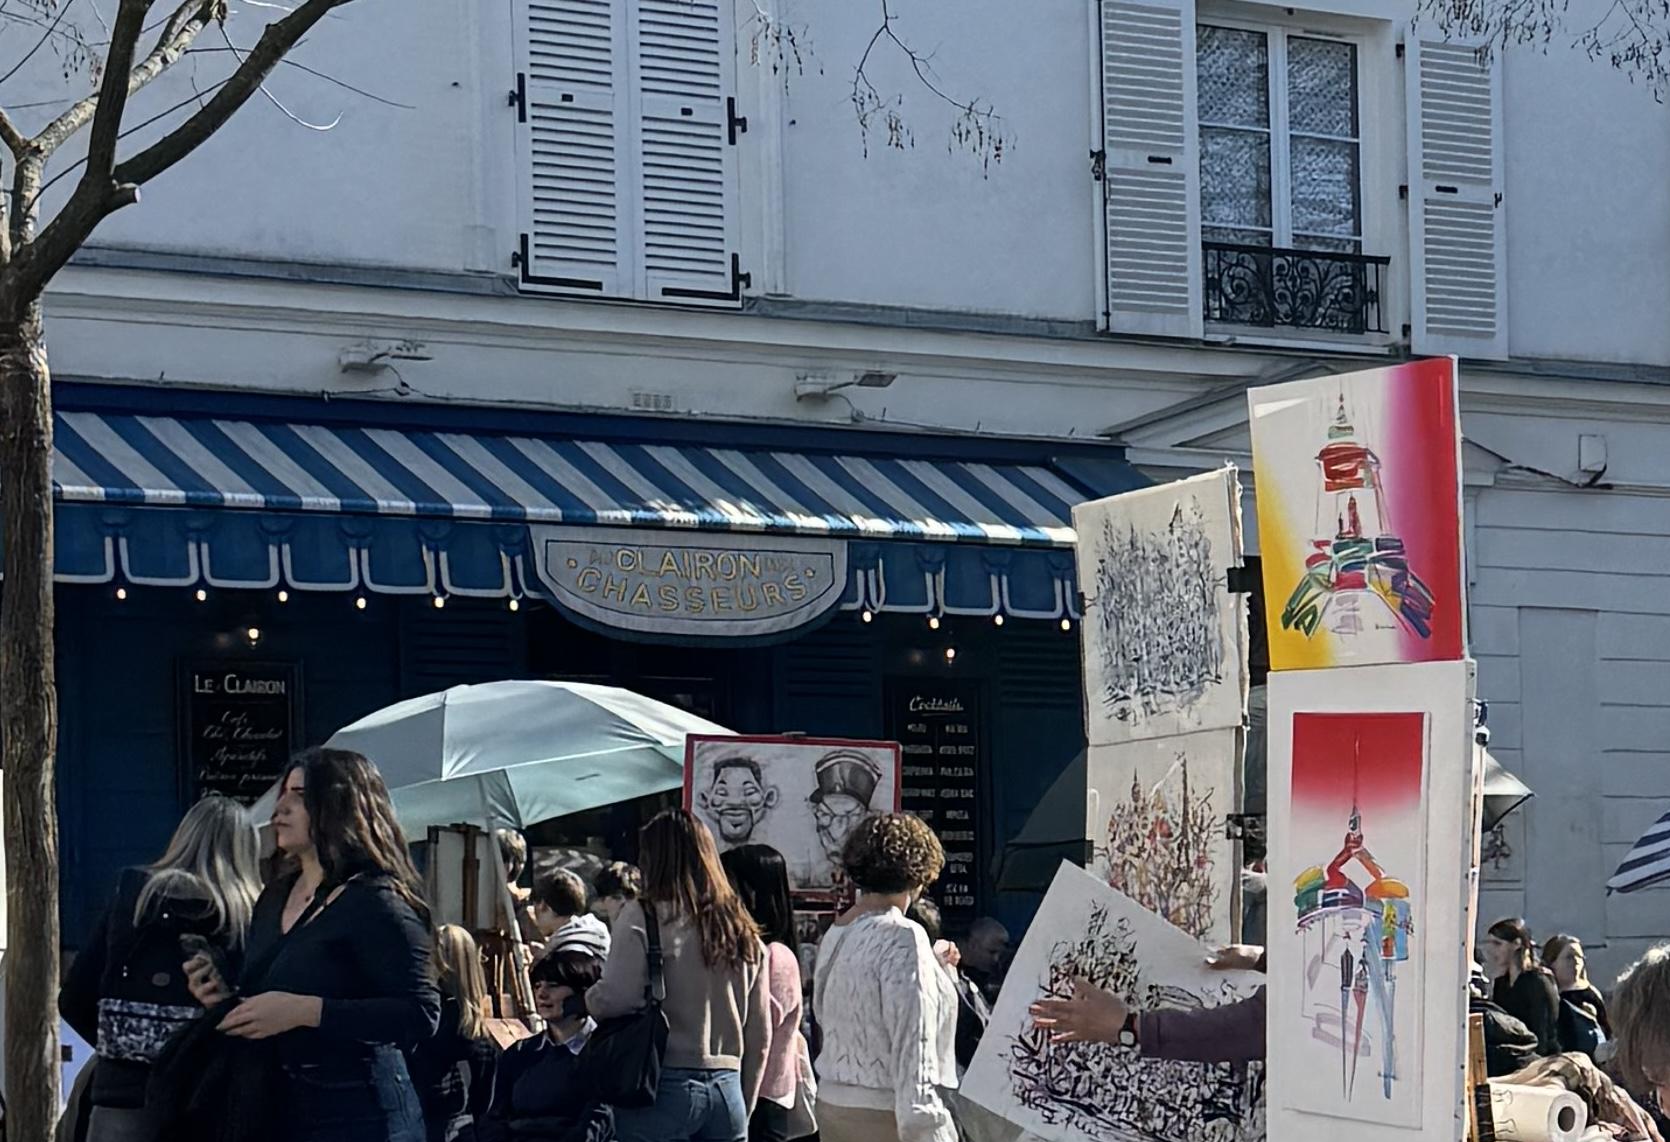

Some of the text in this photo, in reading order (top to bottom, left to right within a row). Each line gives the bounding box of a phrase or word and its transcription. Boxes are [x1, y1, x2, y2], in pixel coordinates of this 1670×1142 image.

[616, 548, 762, 582] CLAIRON
[576, 567, 808, 614] CHASSEURS
[194, 673, 286, 694] LE CLAIRON
